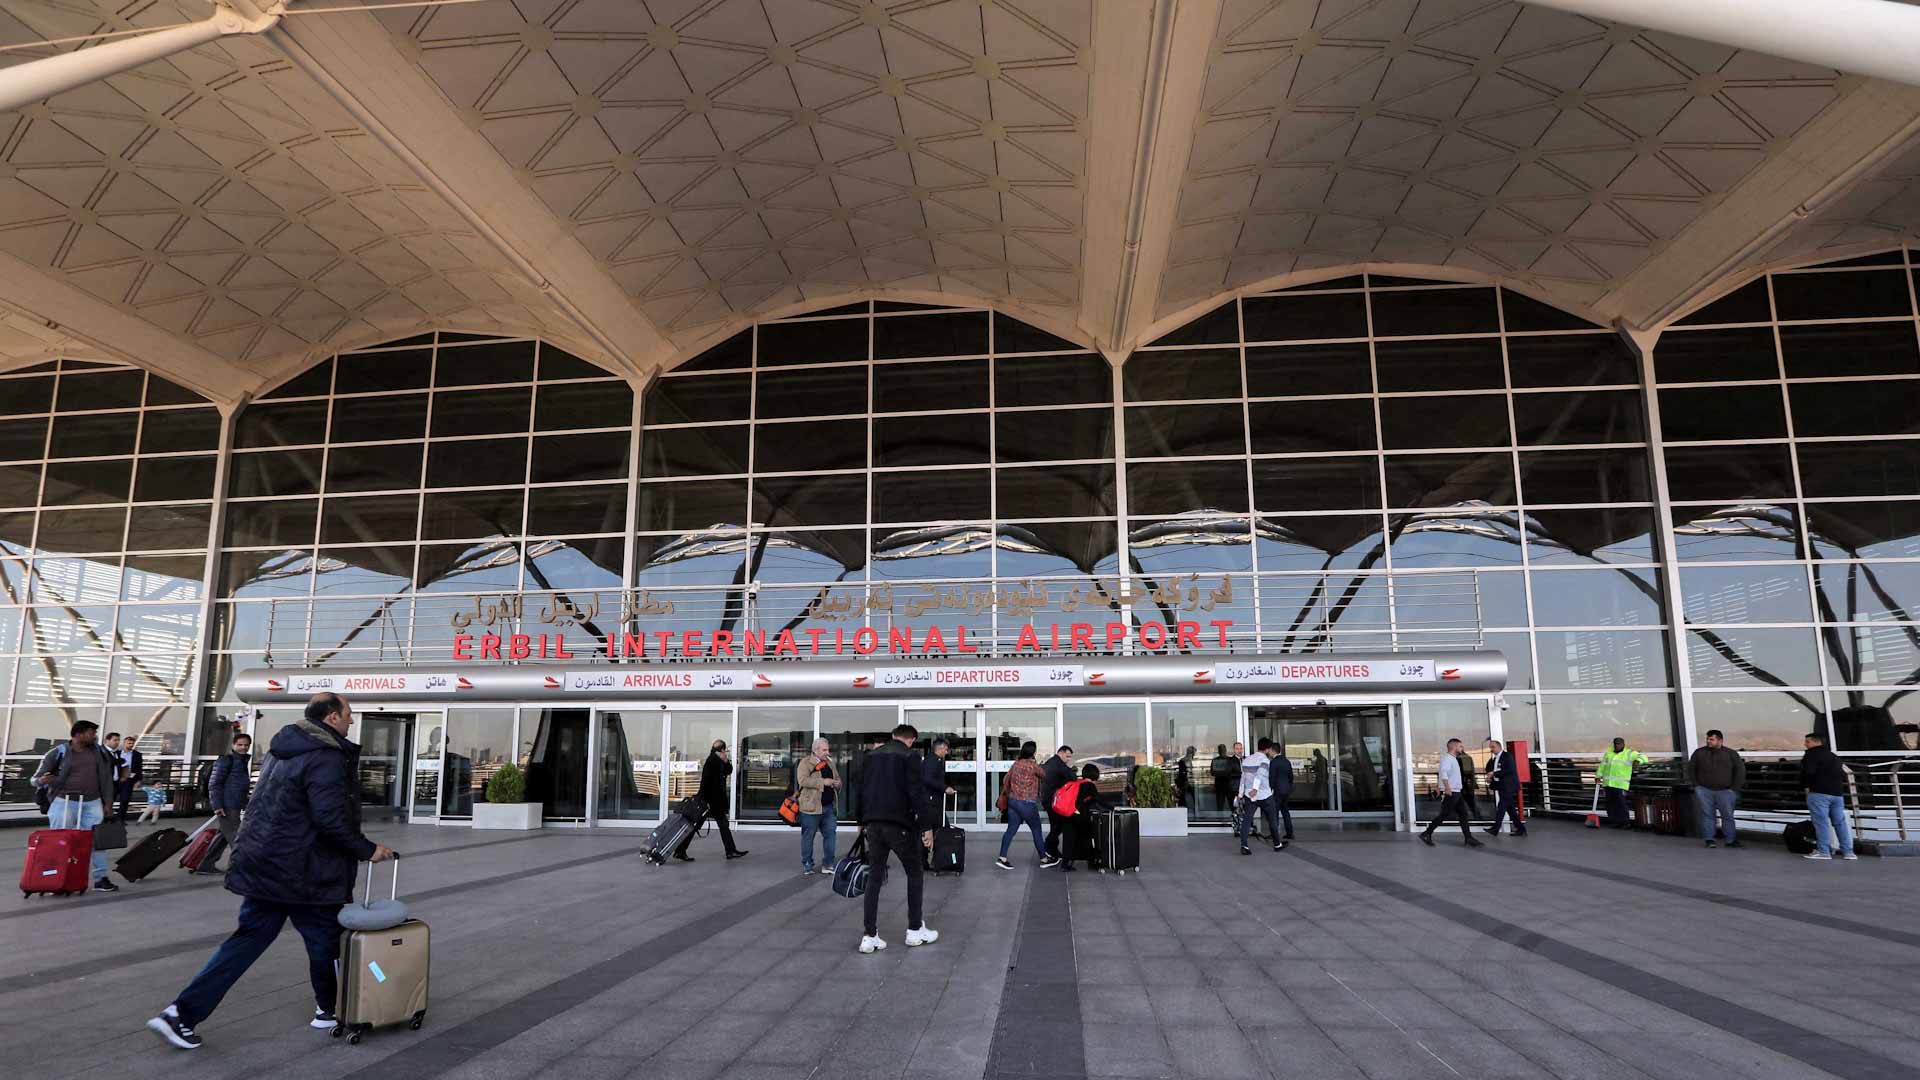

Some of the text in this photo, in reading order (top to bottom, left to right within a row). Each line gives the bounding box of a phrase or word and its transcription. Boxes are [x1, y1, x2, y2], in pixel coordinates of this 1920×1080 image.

[453, 619, 1234, 660] ERBIL INTERNATIONAL AIRPORT
[936, 670, 1020, 683] DEPARTURES
[1281, 664, 1369, 679] DEPARTURES
[344, 677, 406, 690] ARRIVALS
[623, 674, 692, 687] ARRIVALS
